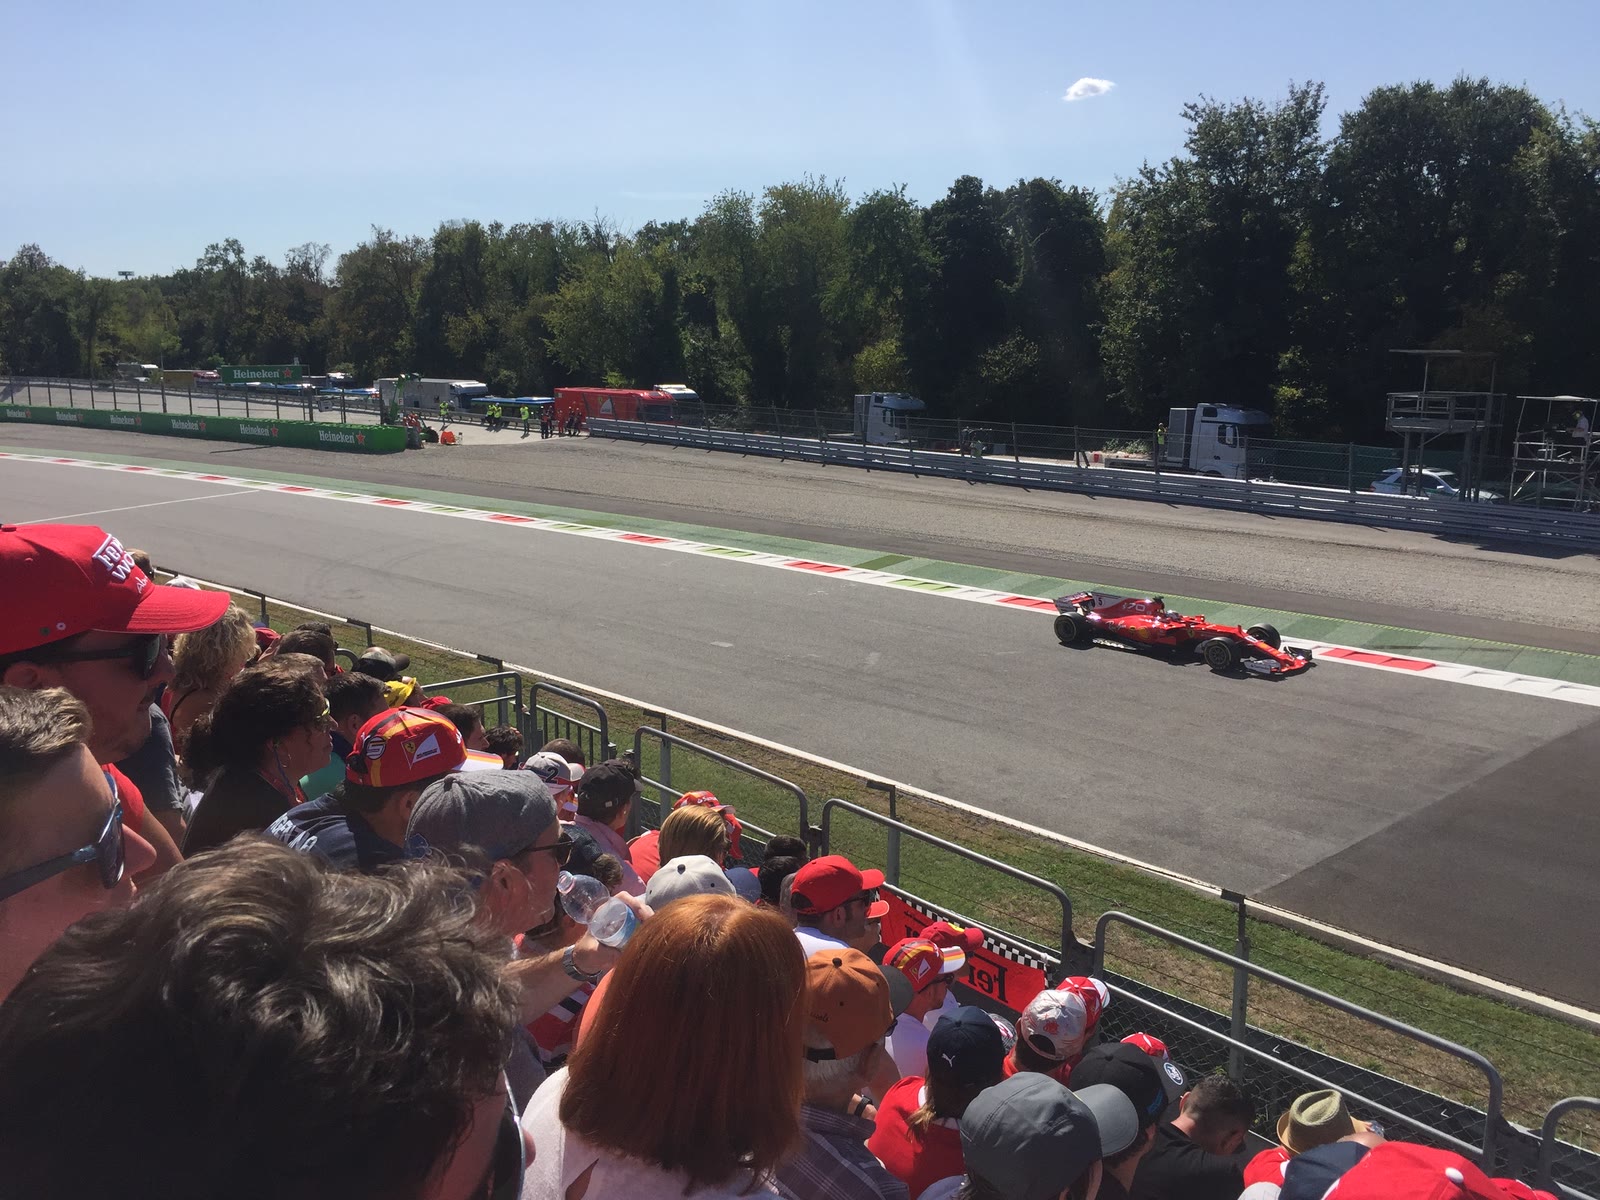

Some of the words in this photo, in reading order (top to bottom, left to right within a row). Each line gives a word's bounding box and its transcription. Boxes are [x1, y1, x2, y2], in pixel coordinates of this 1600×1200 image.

[233, 369, 279, 379] Heineken
[6, 409, 26, 418] Heineken
[56, 411, 77, 421] Heineken
[110, 415, 135, 425] Heineken
[171, 419, 199, 431] Heineken
[239, 423, 270, 437] Heineken
[319, 430, 355, 443] Heineken
[111, 551, 135, 581] WO
[1098, 597, 1103, 606] 5
